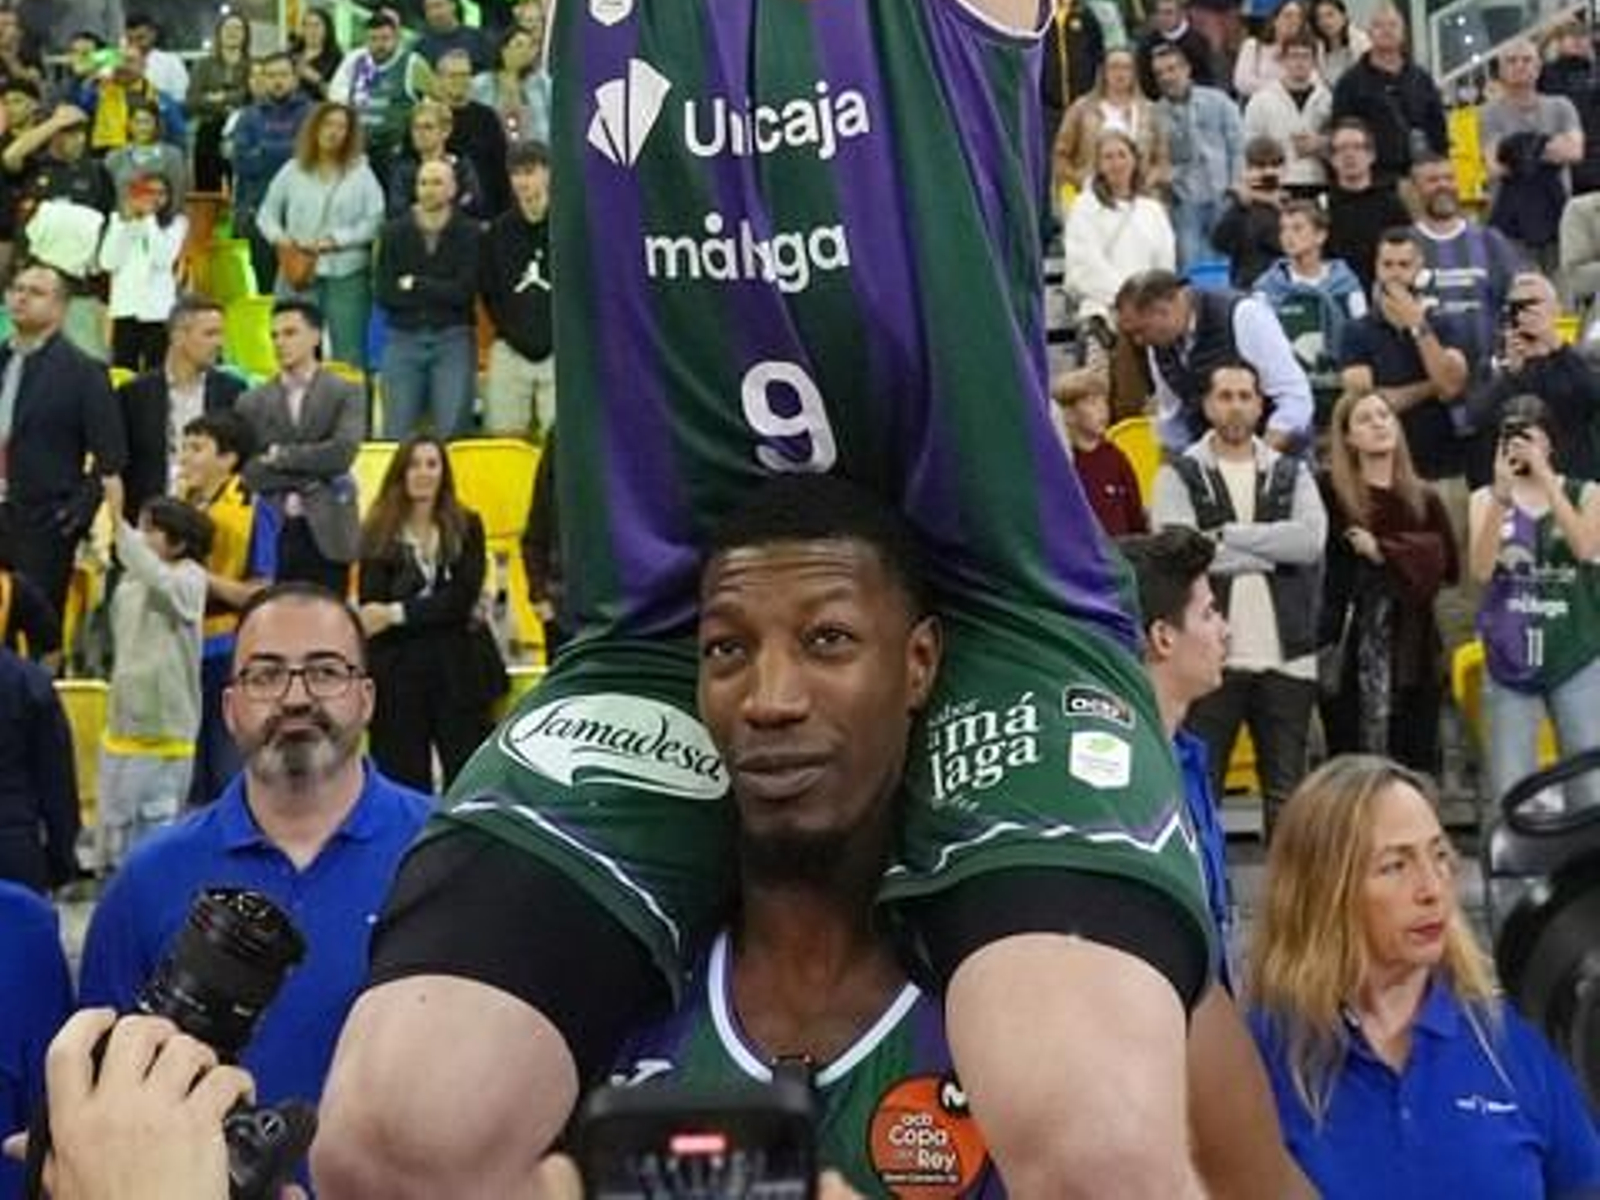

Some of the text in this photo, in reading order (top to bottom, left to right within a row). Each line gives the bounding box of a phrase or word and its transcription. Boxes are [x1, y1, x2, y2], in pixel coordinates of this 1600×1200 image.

[742, 361, 837, 473] 9
[888, 1125, 948, 1146] Copa
[918, 1148, 957, 1173] Rey
